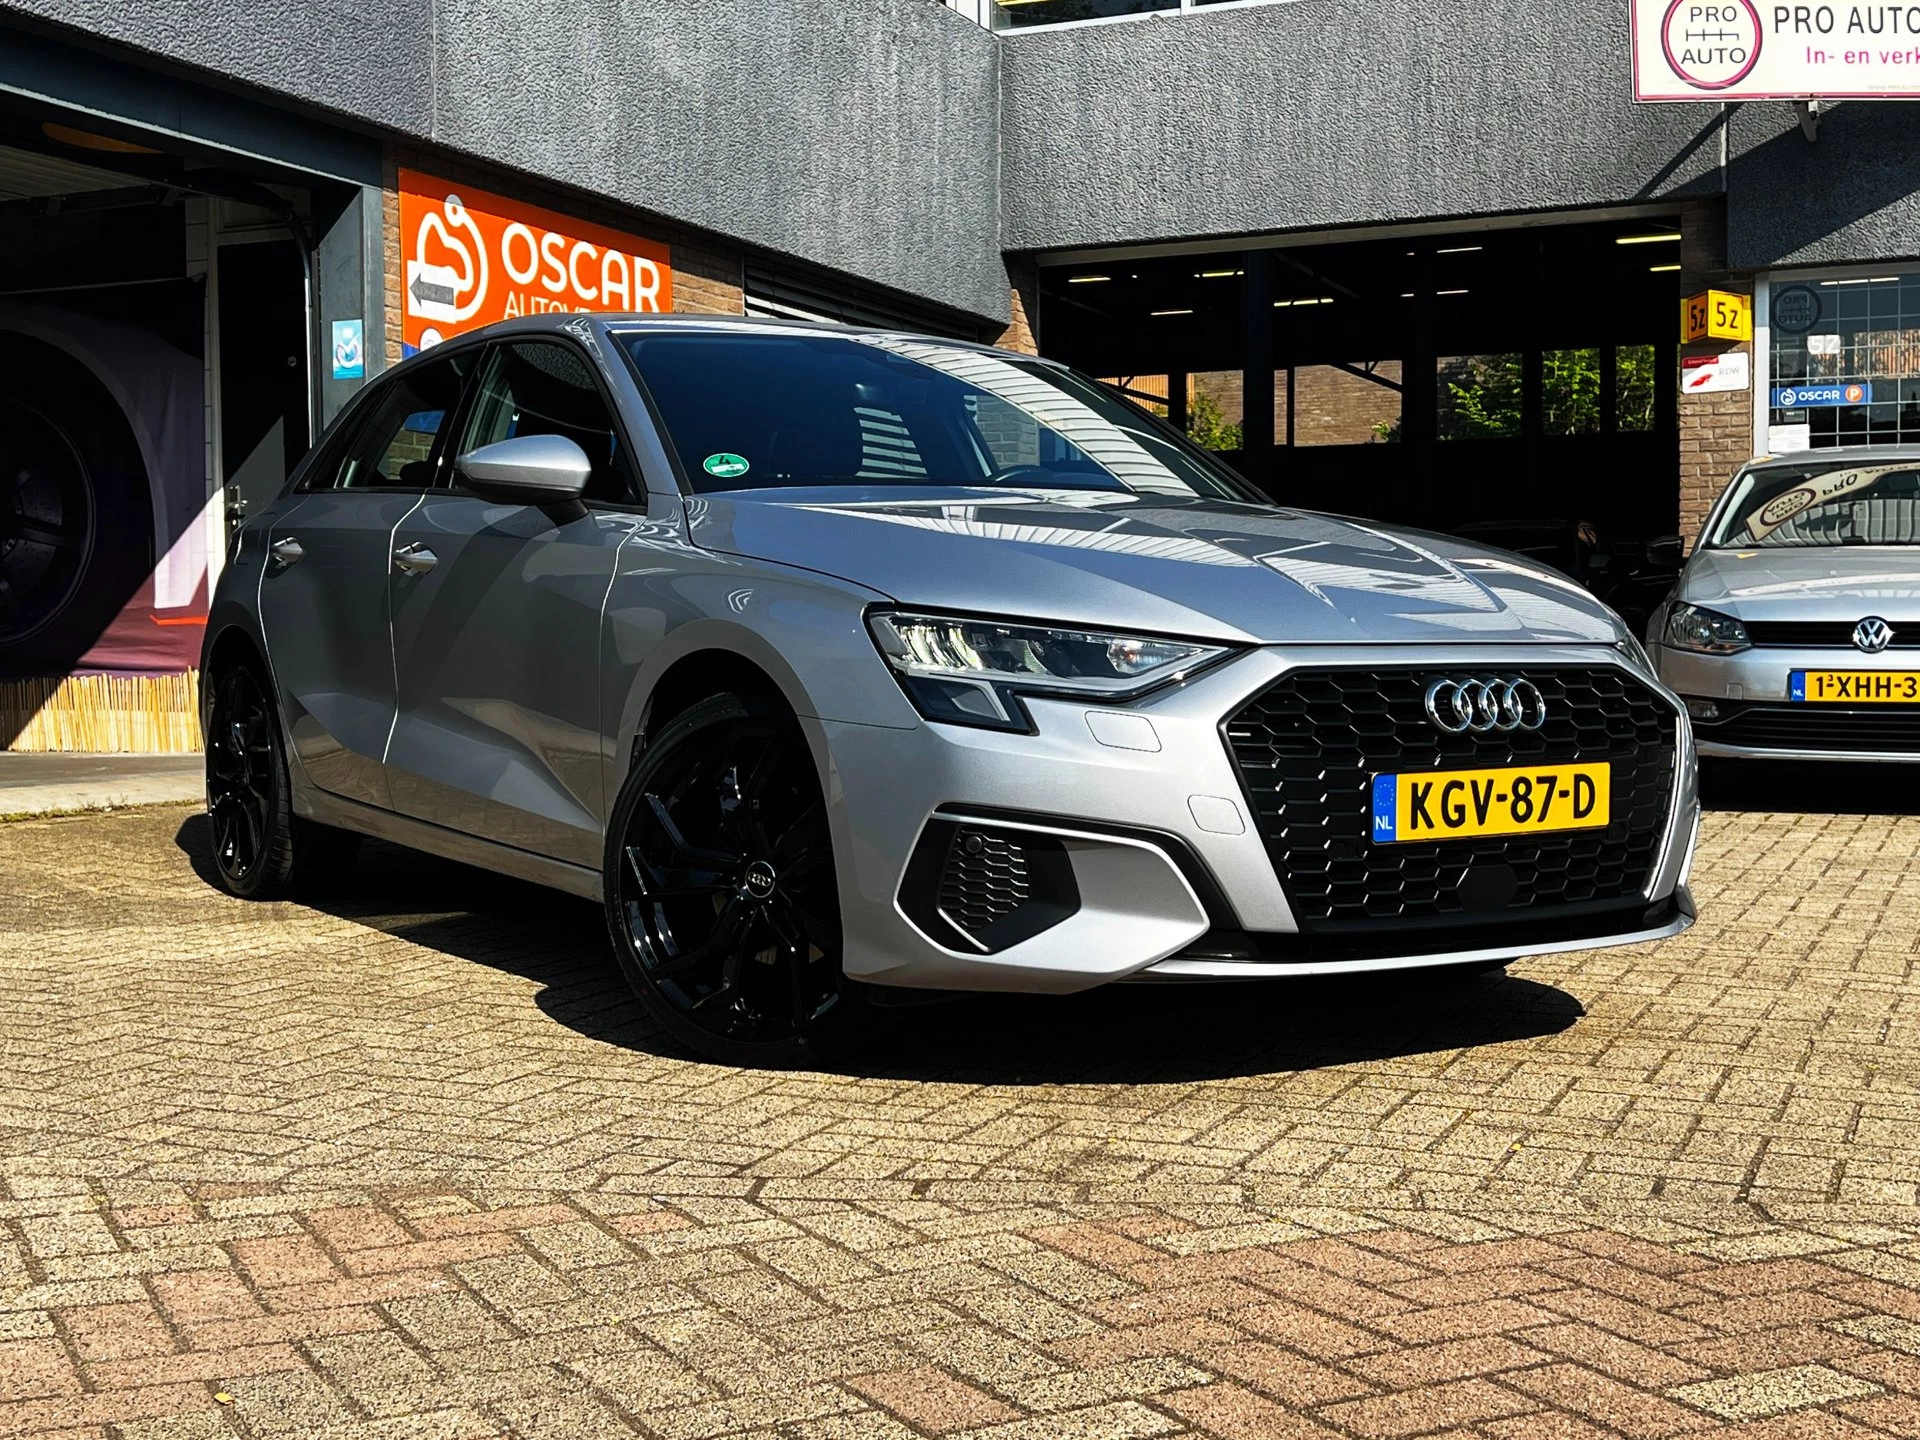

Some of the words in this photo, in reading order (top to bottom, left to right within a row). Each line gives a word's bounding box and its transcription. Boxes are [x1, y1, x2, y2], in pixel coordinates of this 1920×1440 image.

[1690, 6, 1737, 22] PRO
[1774, 6, 1835, 34] PRO
[1847, 6, 1920, 34] AUTO
[1681, 48, 1746, 64] AUTO
[1806, 47, 1835, 64] In-
[1844, 51, 1869, 64] en
[501, 222, 660, 313] OSCAR
[1719, 367, 1740, 376] RDW
[1798, 390, 1840, 401] OSCAR
[1375, 815, 1393, 831] NL
[1410, 773, 1596, 830] KGV-87-D
